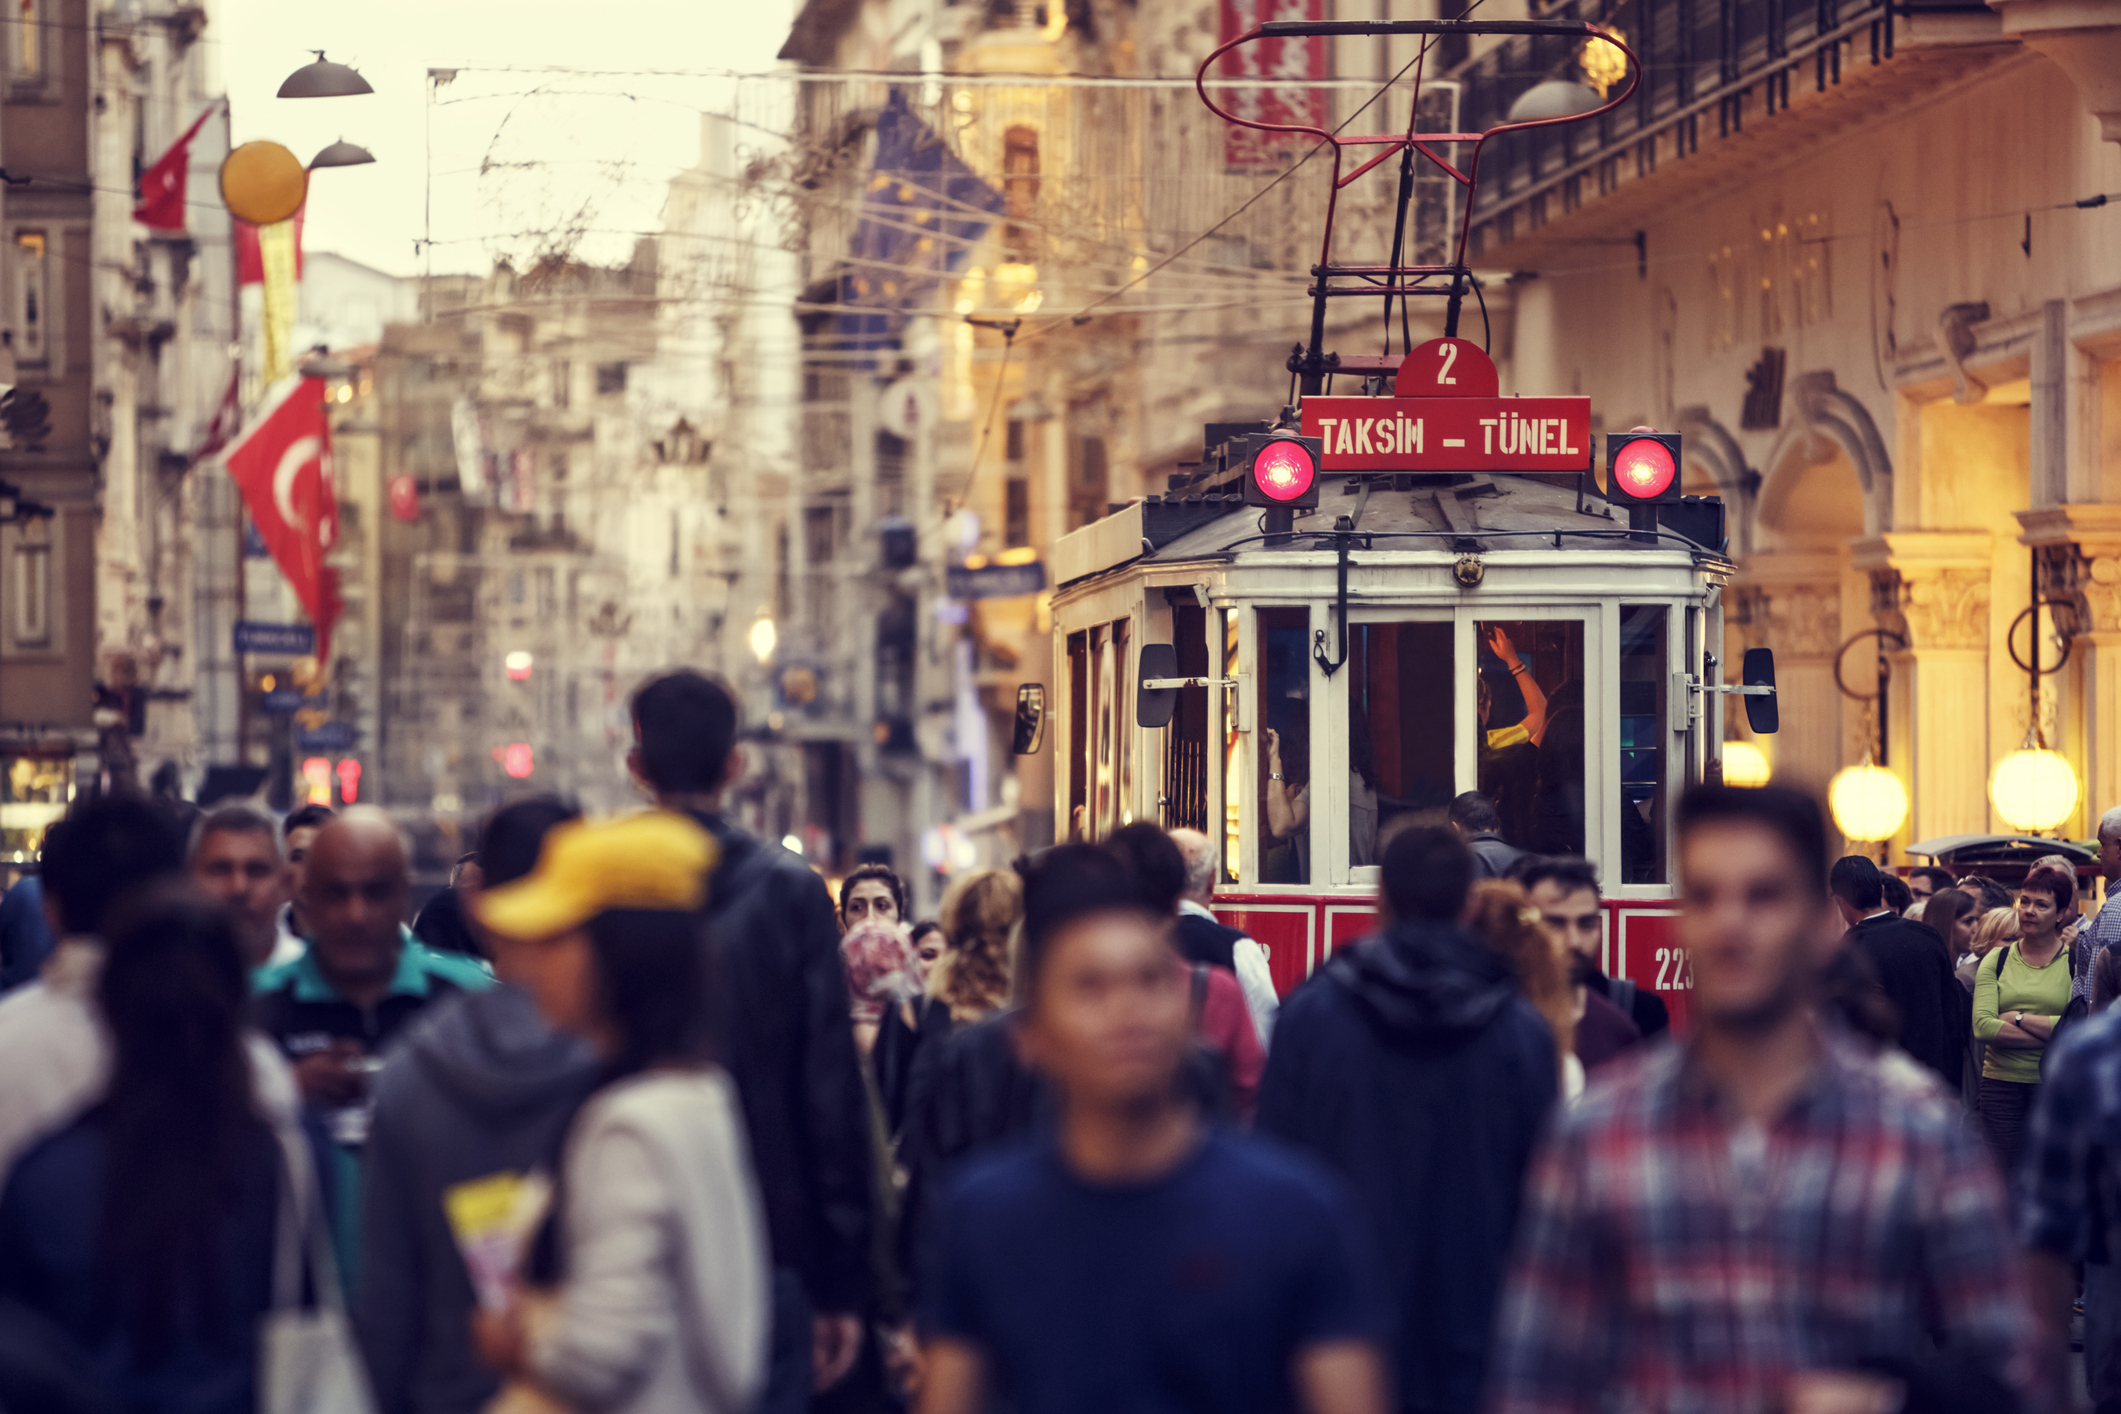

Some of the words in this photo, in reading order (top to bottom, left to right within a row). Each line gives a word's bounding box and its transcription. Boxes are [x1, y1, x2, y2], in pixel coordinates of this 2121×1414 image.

[1437, 343, 1457, 385] 2
[1318, 411, 1424, 455] TAKSİM
[1479, 411, 1579, 455] TÜNEL
